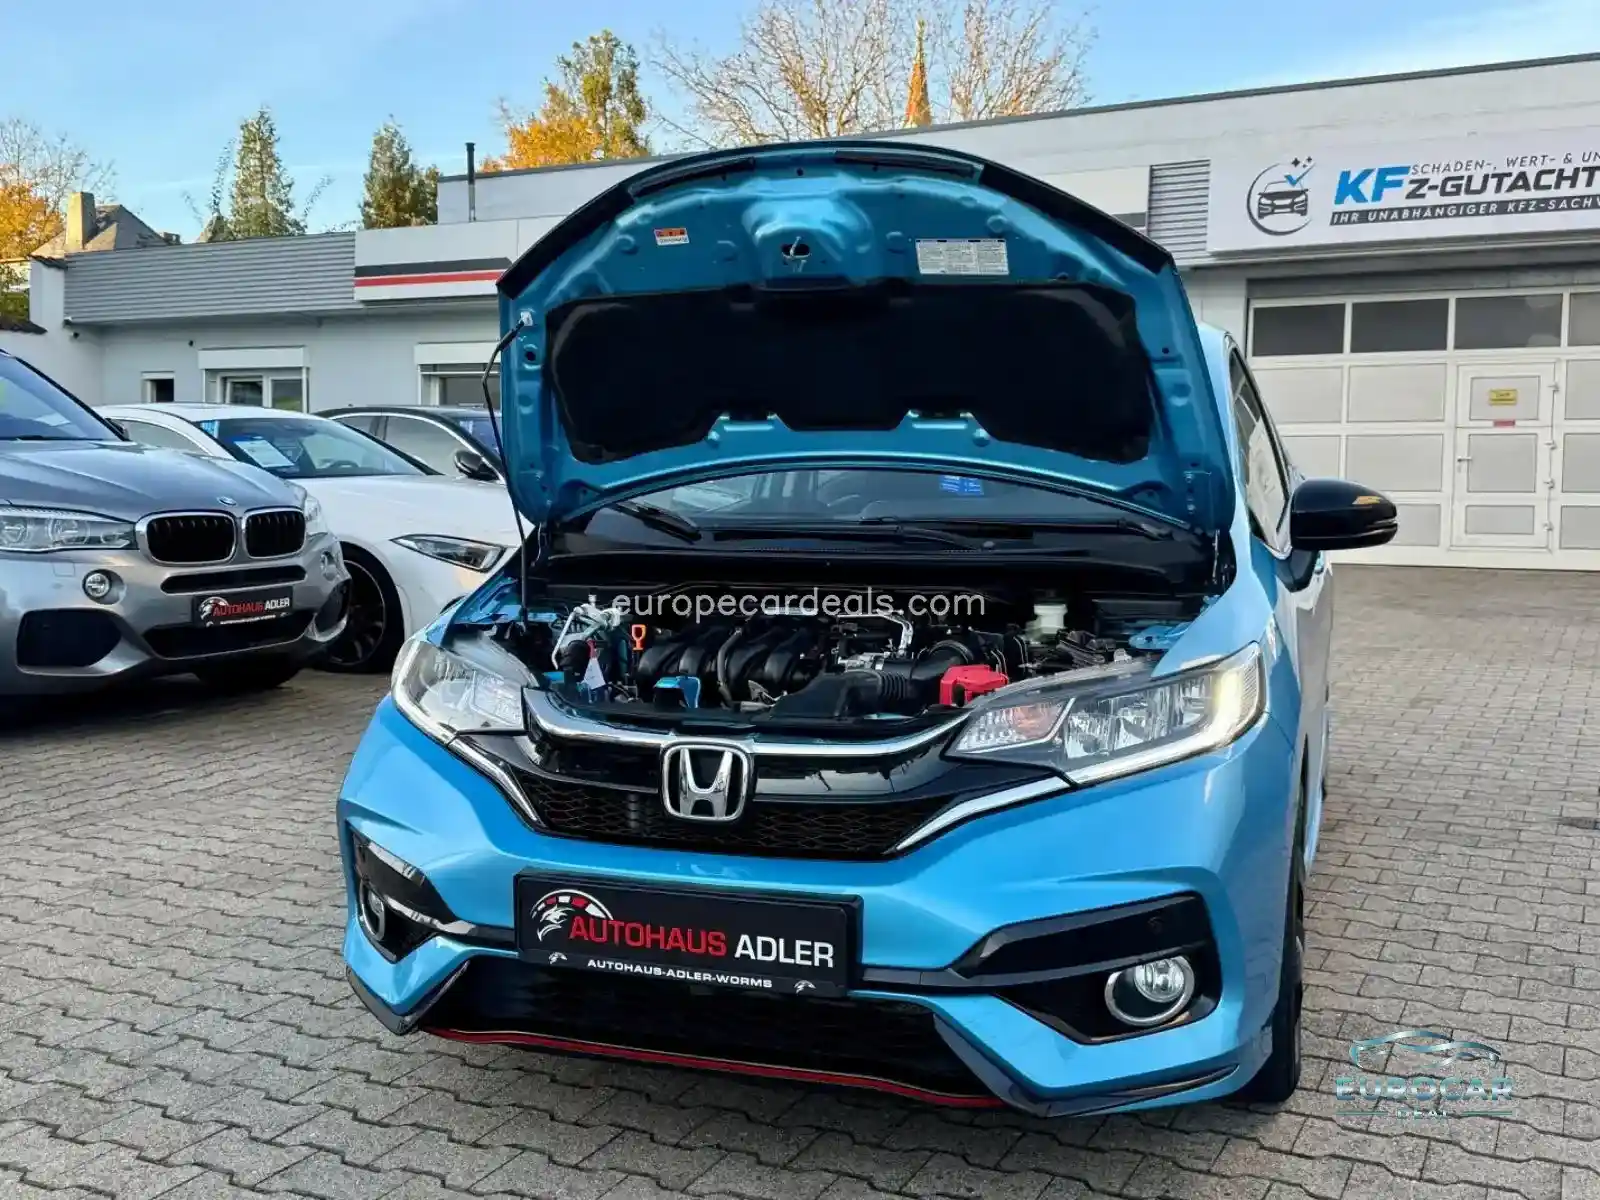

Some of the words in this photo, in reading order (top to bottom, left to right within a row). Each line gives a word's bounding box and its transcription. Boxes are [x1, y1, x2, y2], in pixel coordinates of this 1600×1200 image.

[1506, 154, 1556, 168] WERT-
[1563, 152, 1573, 164] &
[1333, 212, 1360, 225] IHR
[264, 597, 290, 611] ADLER
[568, 914, 727, 957] AUTOHAUS
[733, 933, 835, 969] ADLER
[586, 957, 774, 989] AUTOHAUS-ADLER-WORMS
